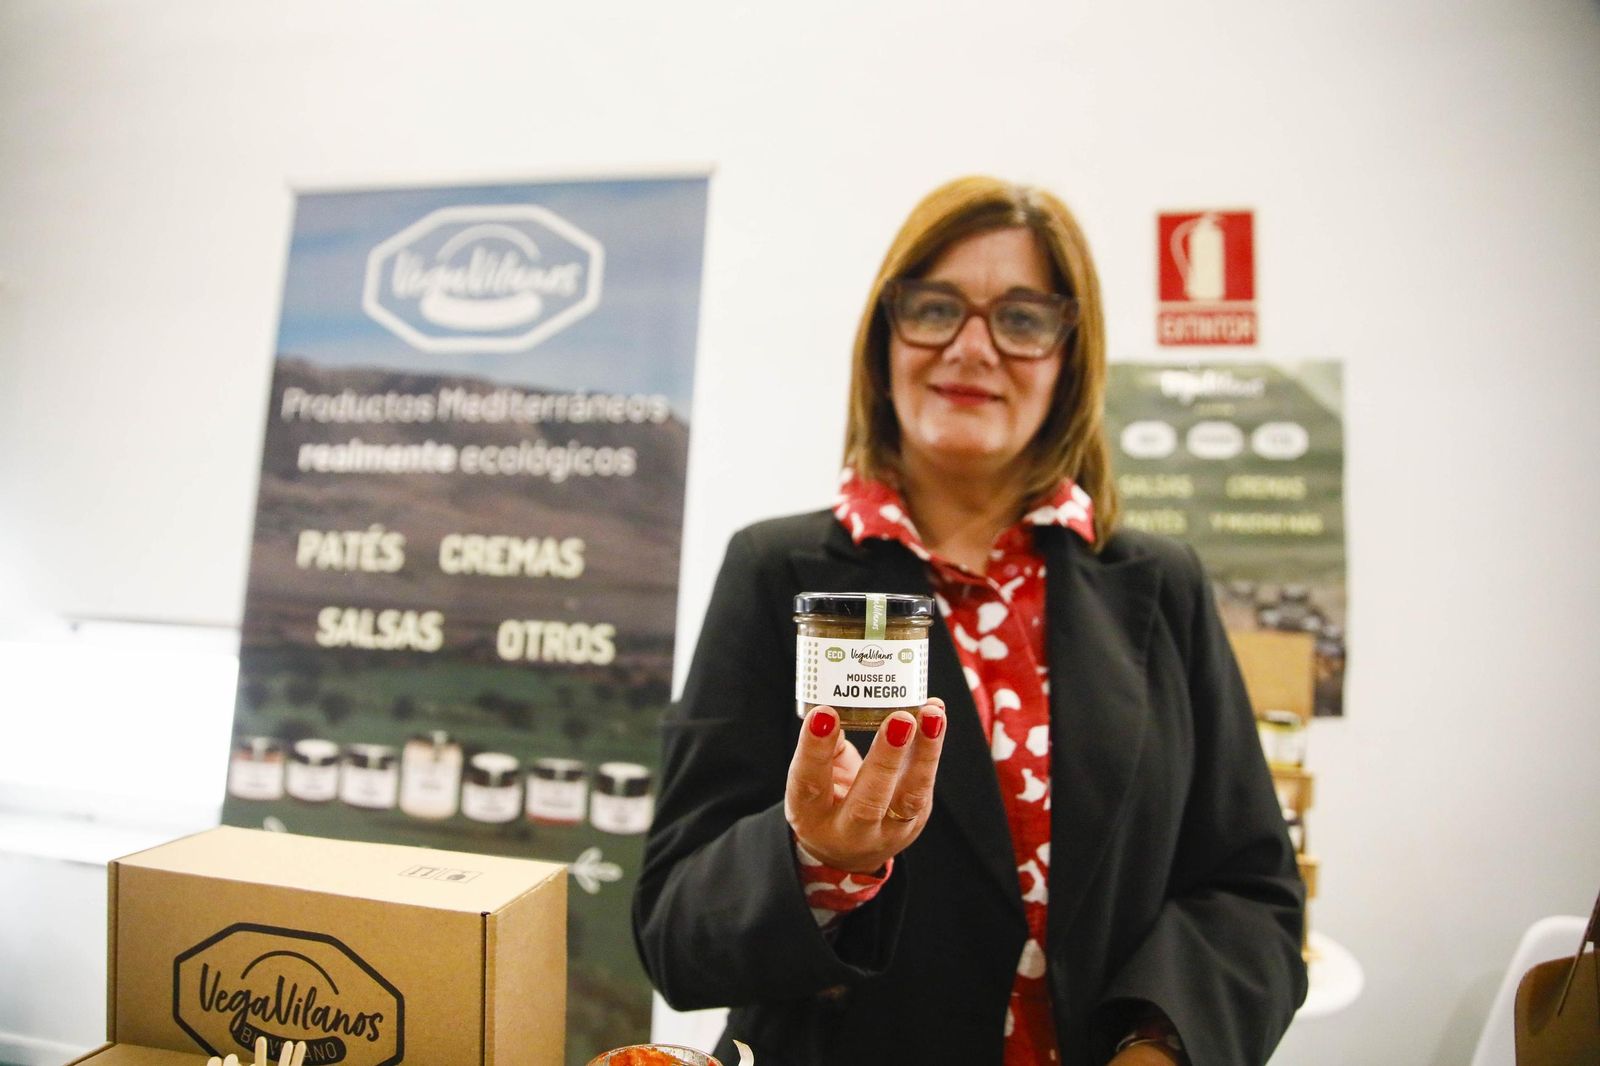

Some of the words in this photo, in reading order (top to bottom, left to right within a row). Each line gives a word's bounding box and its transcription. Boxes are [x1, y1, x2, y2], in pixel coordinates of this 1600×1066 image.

[1163, 317, 1252, 339] EXTINTOR
[281, 387, 433, 423] Productos
[437, 387, 670, 424] Mediterráneos
[297, 439, 457, 474] realmente
[459, 440, 637, 484] ecológicos
[296, 524, 405, 572] PATÉS
[439, 533, 585, 579] CREMAS
[316, 606, 444, 652] SALSAS
[497, 619, 616, 666] OTROS
[827, 649, 843, 658] ECO
[850, 648, 893, 663] VegaVilanos
[901, 652, 912, 660] BIO
[833, 684, 860, 697] AJO
[863, 686, 907, 698] NEGRO
[846, 673, 883, 682] MOUSSE
[885, 674, 896, 682] DE
[199, 962, 384, 1042] VegaVilanos
